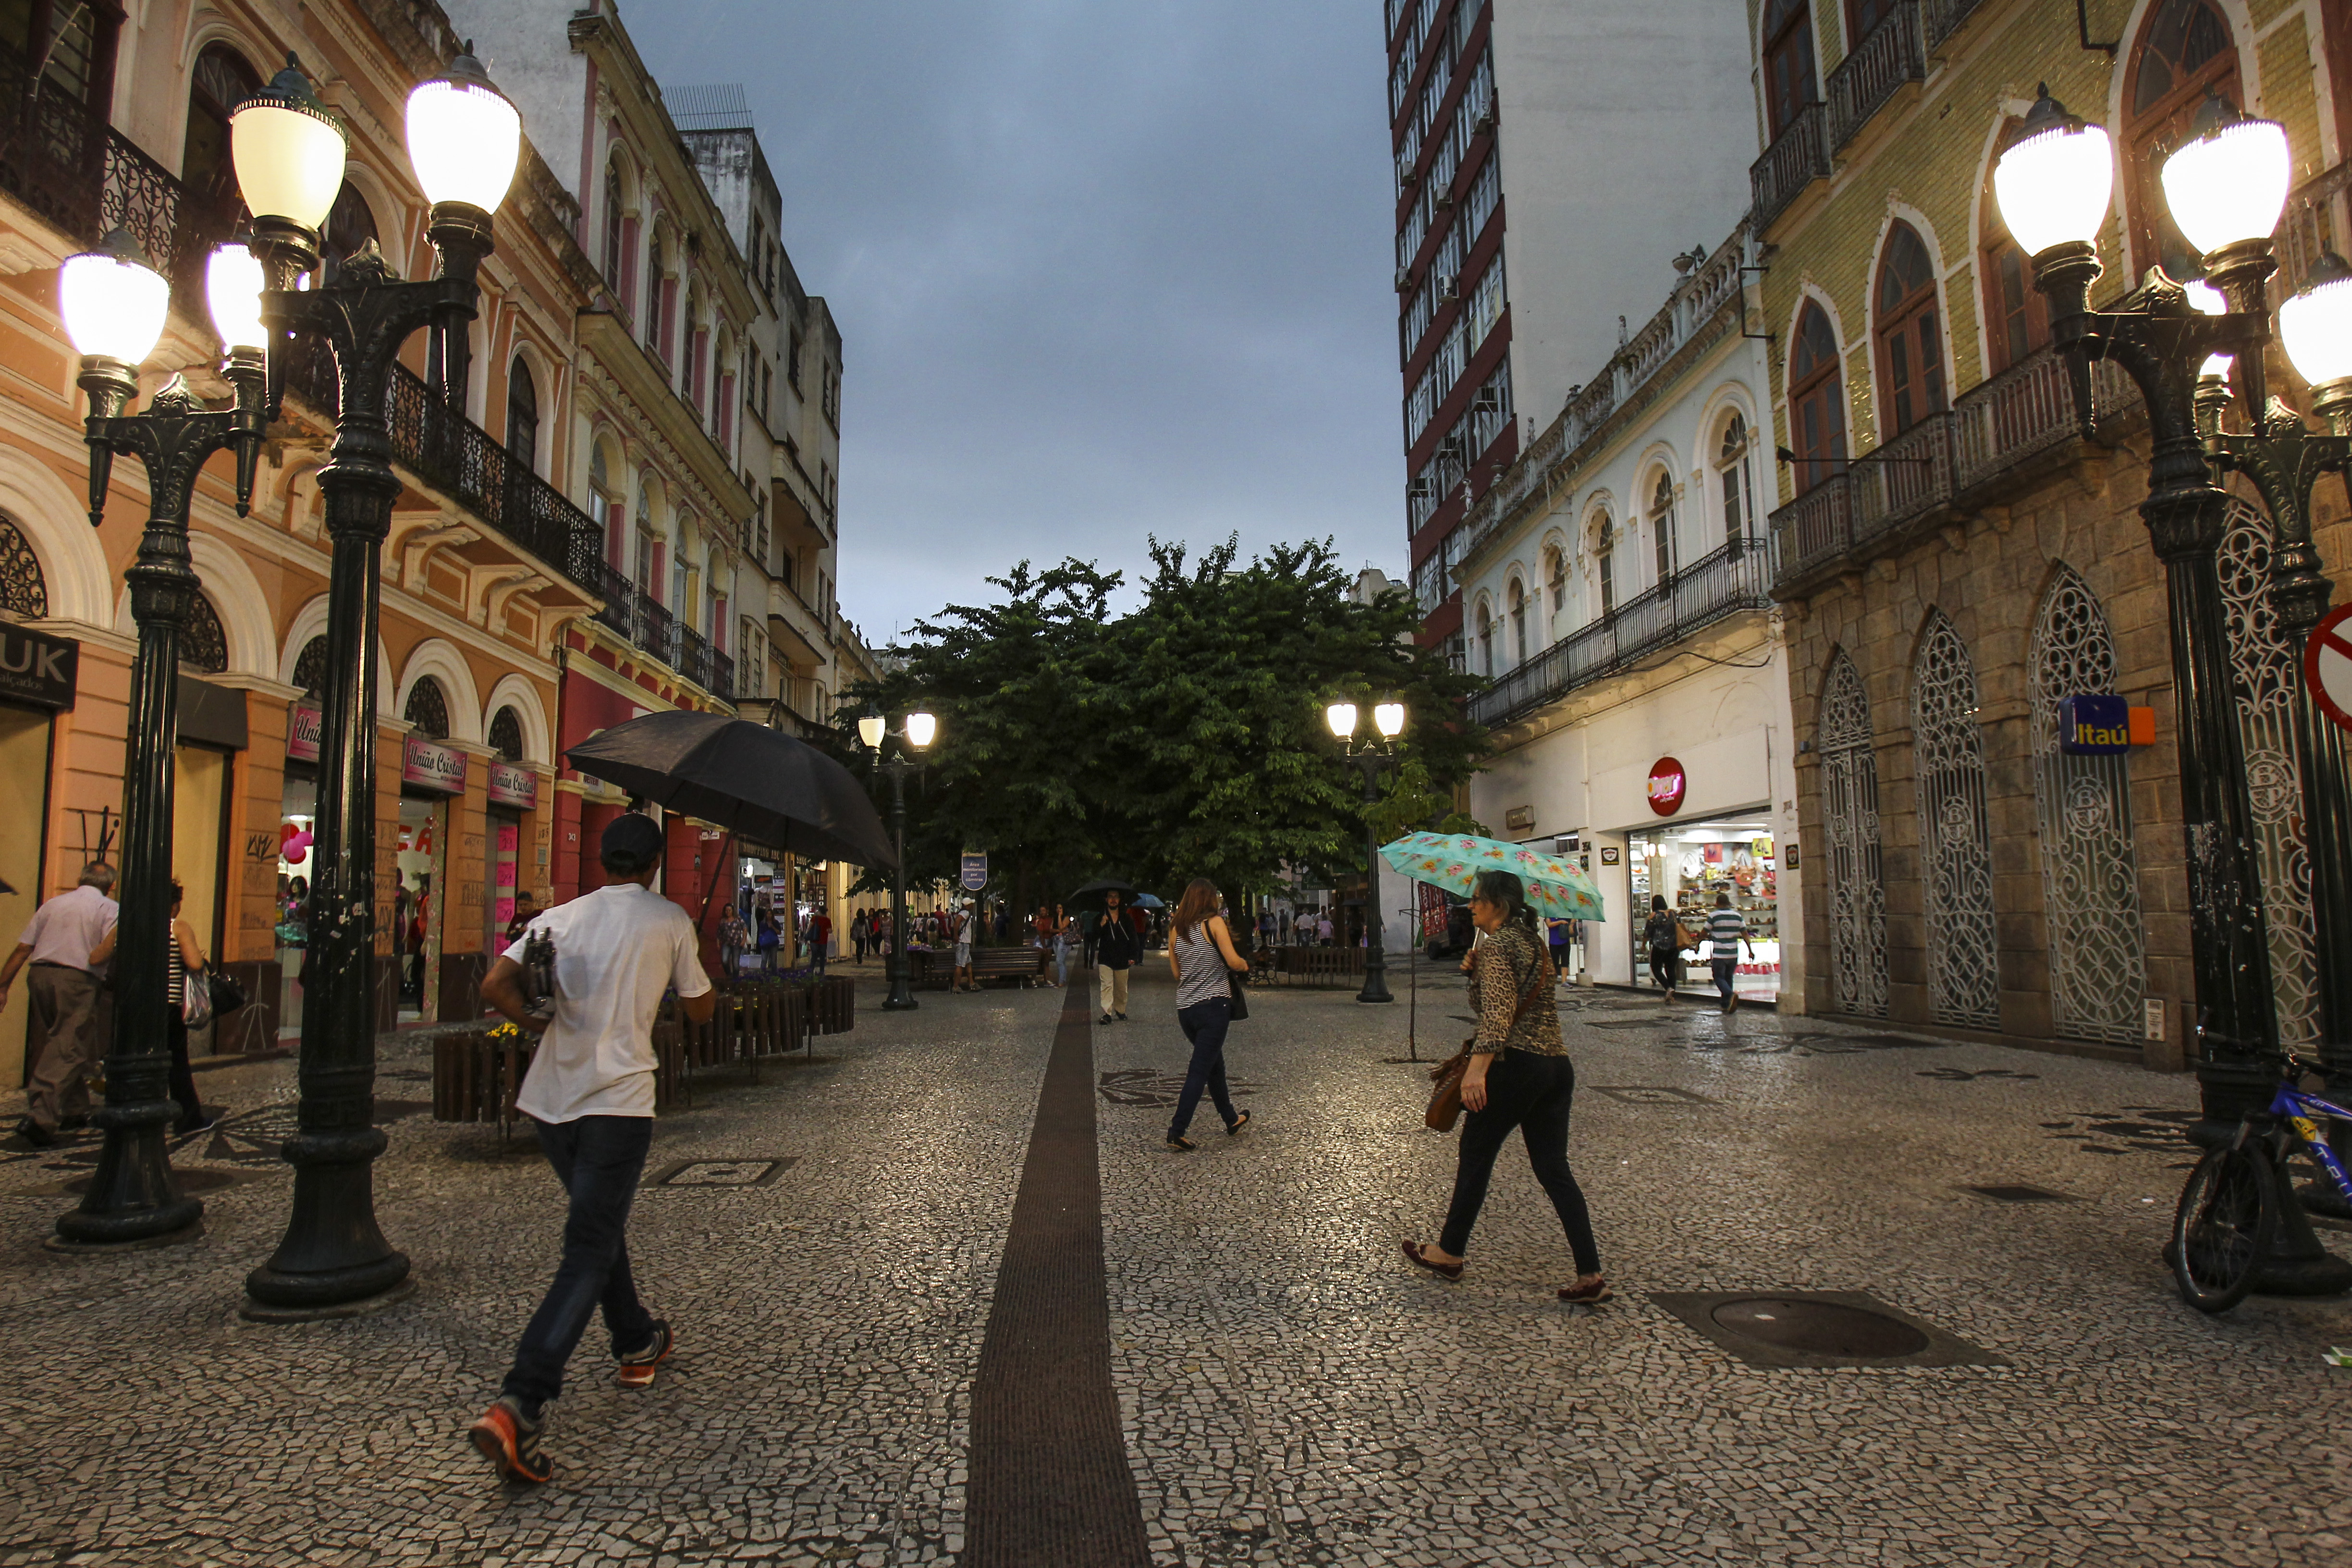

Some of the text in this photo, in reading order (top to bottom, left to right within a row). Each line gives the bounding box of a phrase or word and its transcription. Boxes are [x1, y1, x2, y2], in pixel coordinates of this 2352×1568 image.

[0, 672, 44, 691] alçados
[297, 714, 320, 744] Uni
[2078, 723, 2128, 745] Itaú
[409, 743, 466, 778] União Cristal
[492, 767, 535, 795] União Cristal
[568, 833, 576, 841] 343
